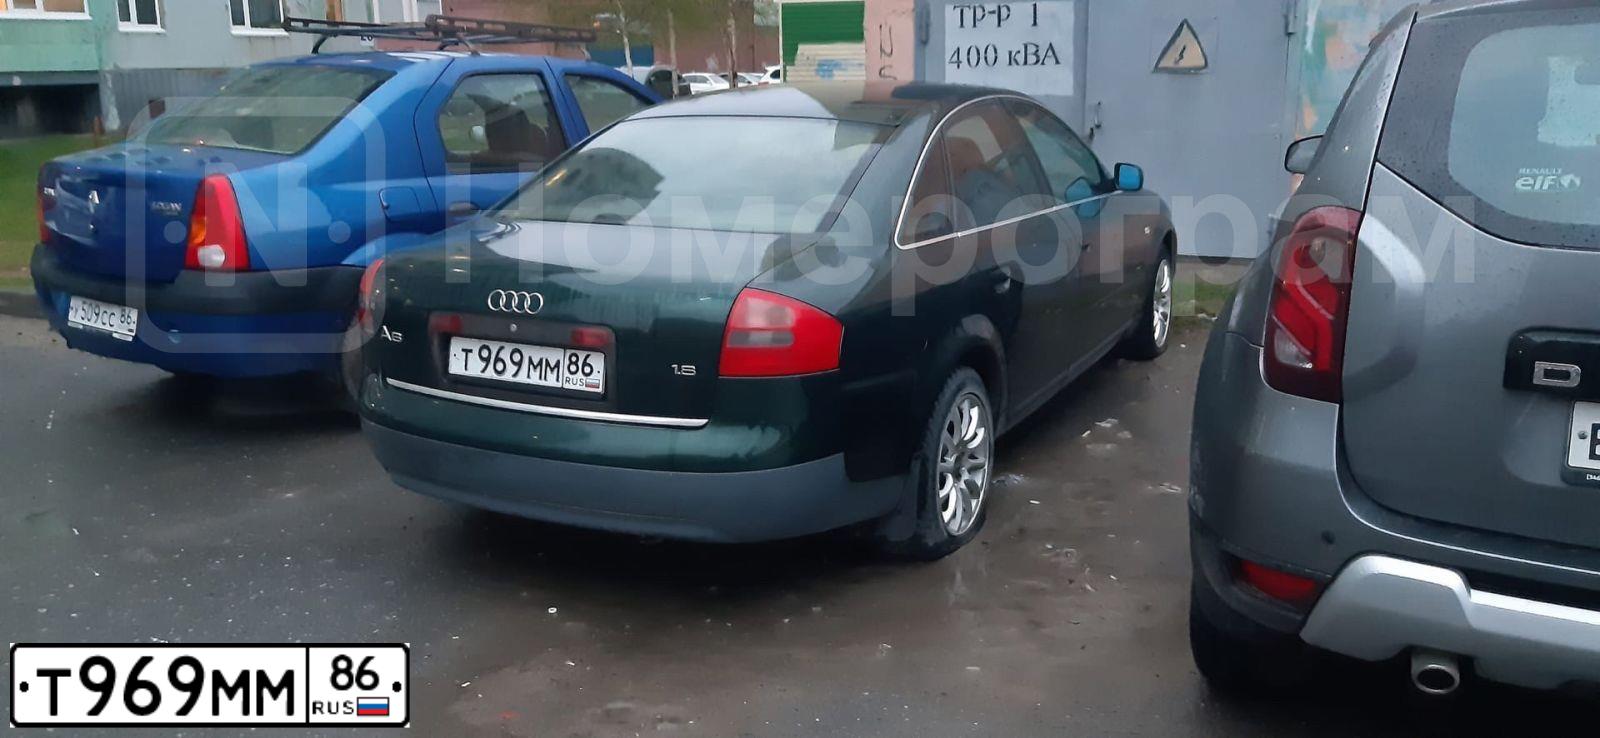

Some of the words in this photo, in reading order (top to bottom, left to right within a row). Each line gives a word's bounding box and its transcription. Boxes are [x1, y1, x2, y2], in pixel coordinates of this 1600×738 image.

[1031, 2, 1039, 27] 1
[949, 43, 998, 69] 400
[1007, 42, 1061, 67] кВА
[566, 352, 592, 376] 86
[564, 376, 585, 388] RUS
